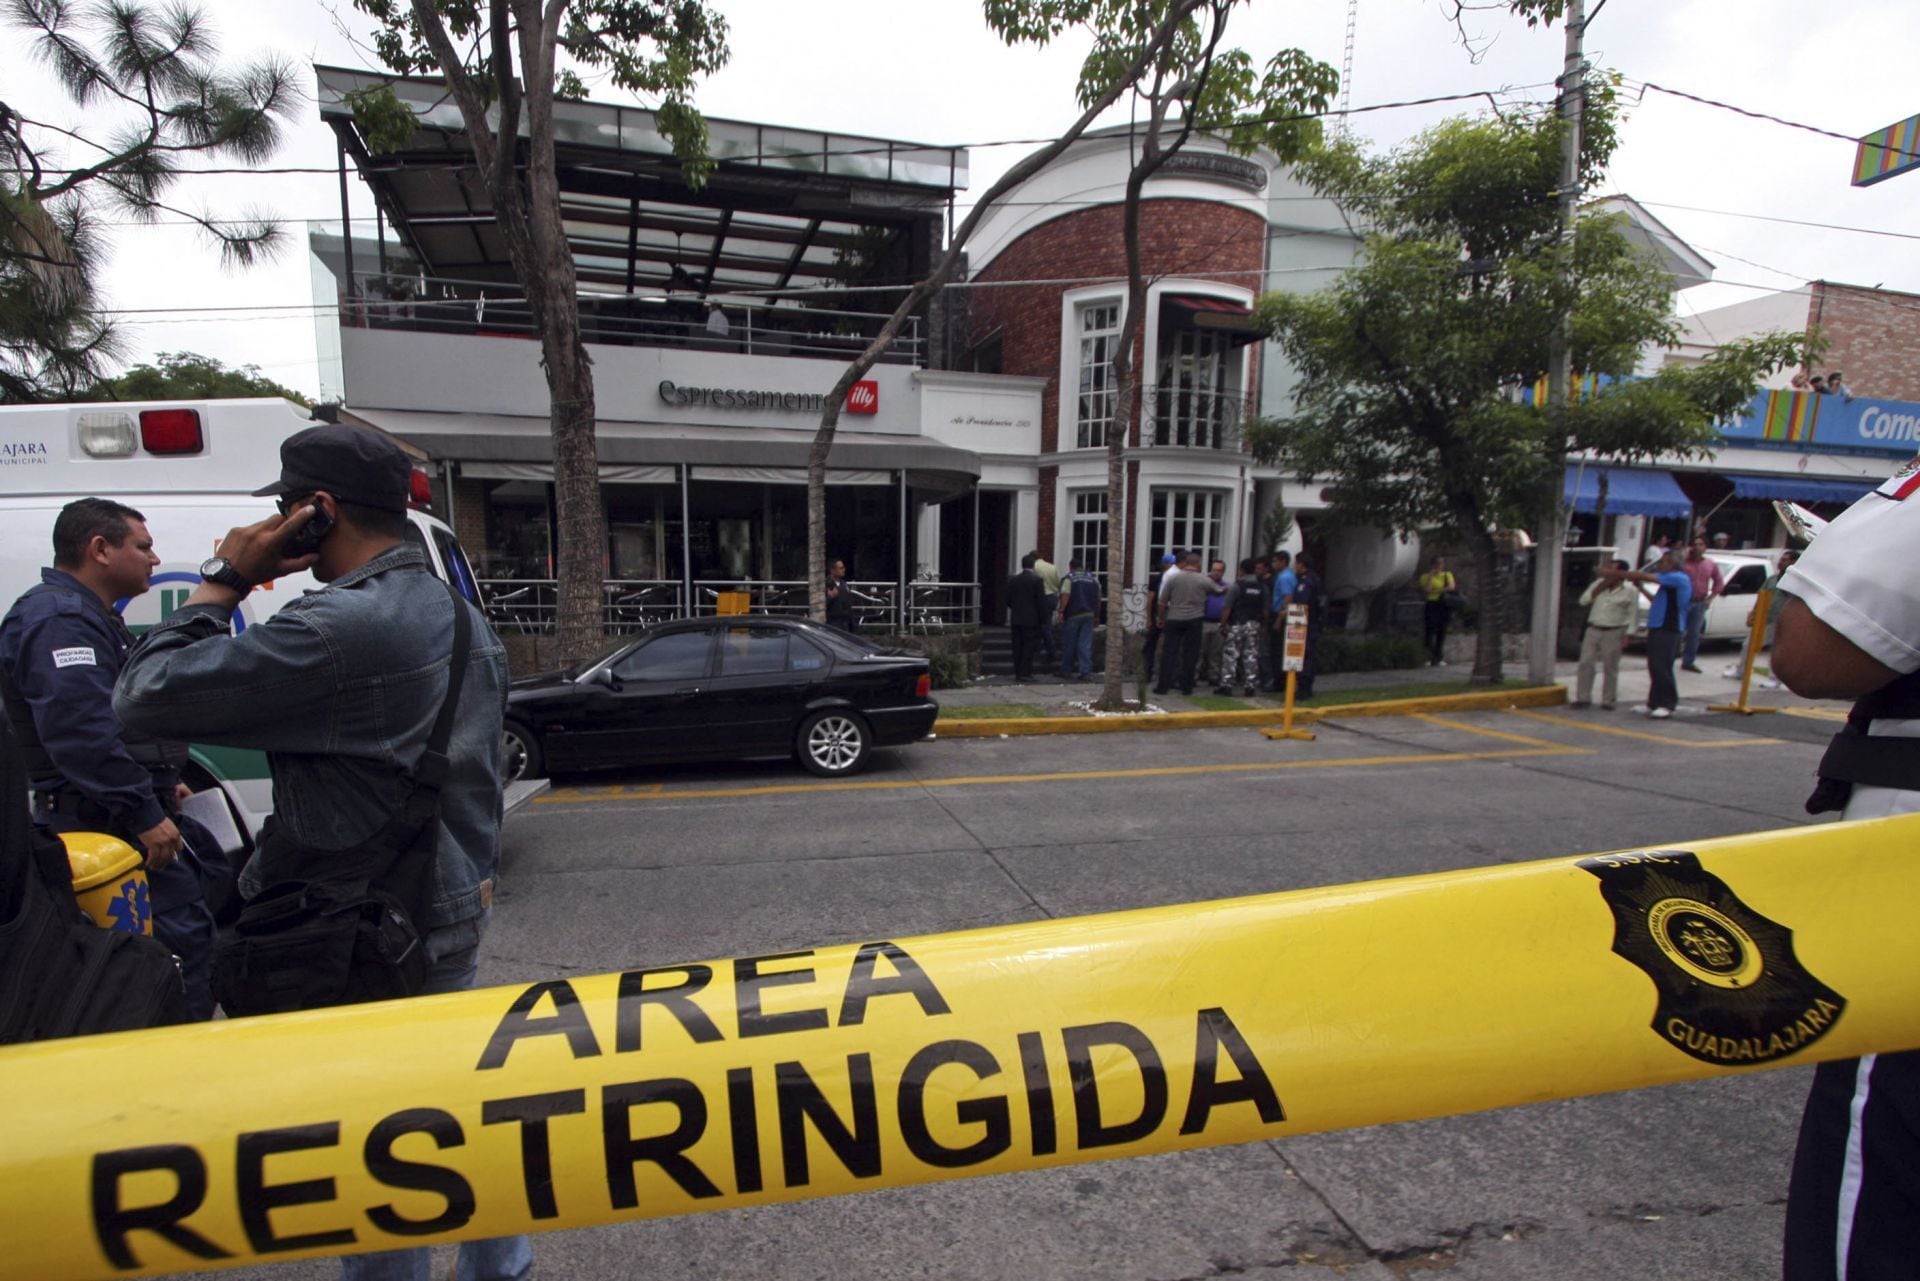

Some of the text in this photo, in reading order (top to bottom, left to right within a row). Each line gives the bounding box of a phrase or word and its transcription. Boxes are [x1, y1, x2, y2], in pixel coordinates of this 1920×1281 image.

[851, 386, 875, 407] illy
[475, 942, 952, 1071] AREA
[1667, 998, 1838, 1059] GUADALAJARA
[90, 1007, 1287, 1270] RESTRINGIDA
